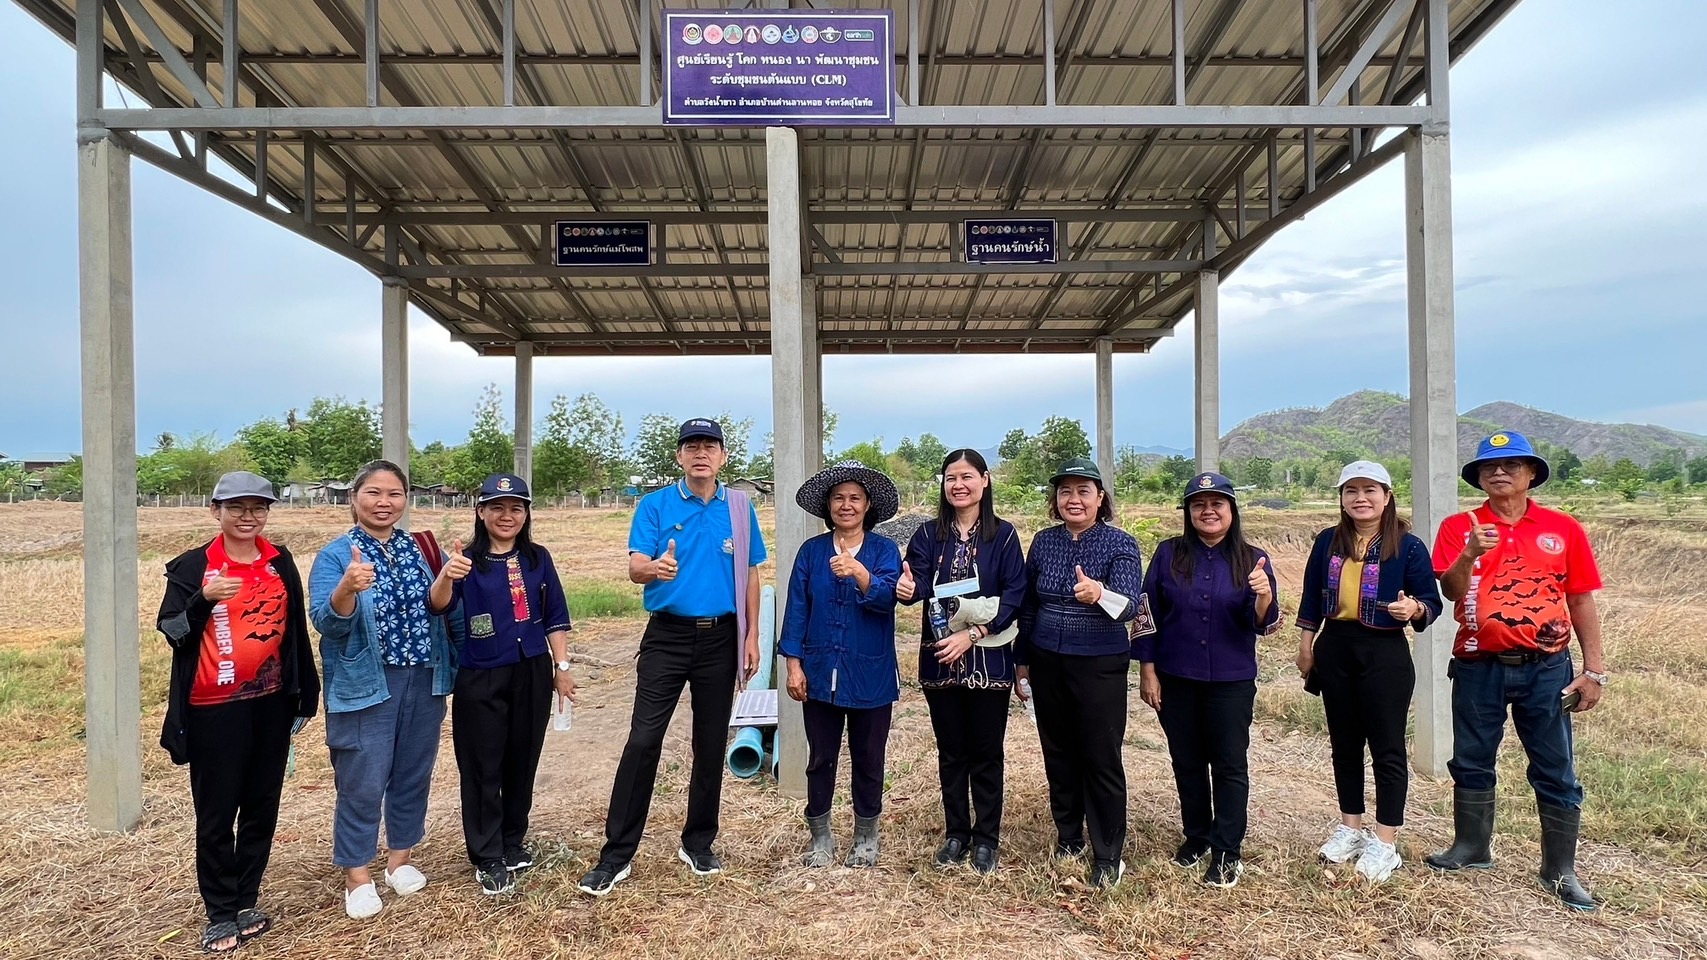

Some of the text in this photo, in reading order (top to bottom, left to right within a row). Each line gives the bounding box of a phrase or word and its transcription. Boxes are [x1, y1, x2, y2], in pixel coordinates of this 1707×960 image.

[677, 52, 879, 68] ศูนย์เรียนรู้ โคก หนอง นา พัฒนาชุมชน
[710, 73, 847, 87] ระดับชุมชนต้นแบบ (CLM)
[825, 97, 873, 108] จังหวัดสุโขทัย
[562, 244, 644, 255] ฐานคนรักษ์แม่โพสพ
[971, 237, 1050, 256] ฐานคนรักษ์น้ำ
[211, 603, 233, 656] NUMBER
[217, 660, 235, 686] ONE
